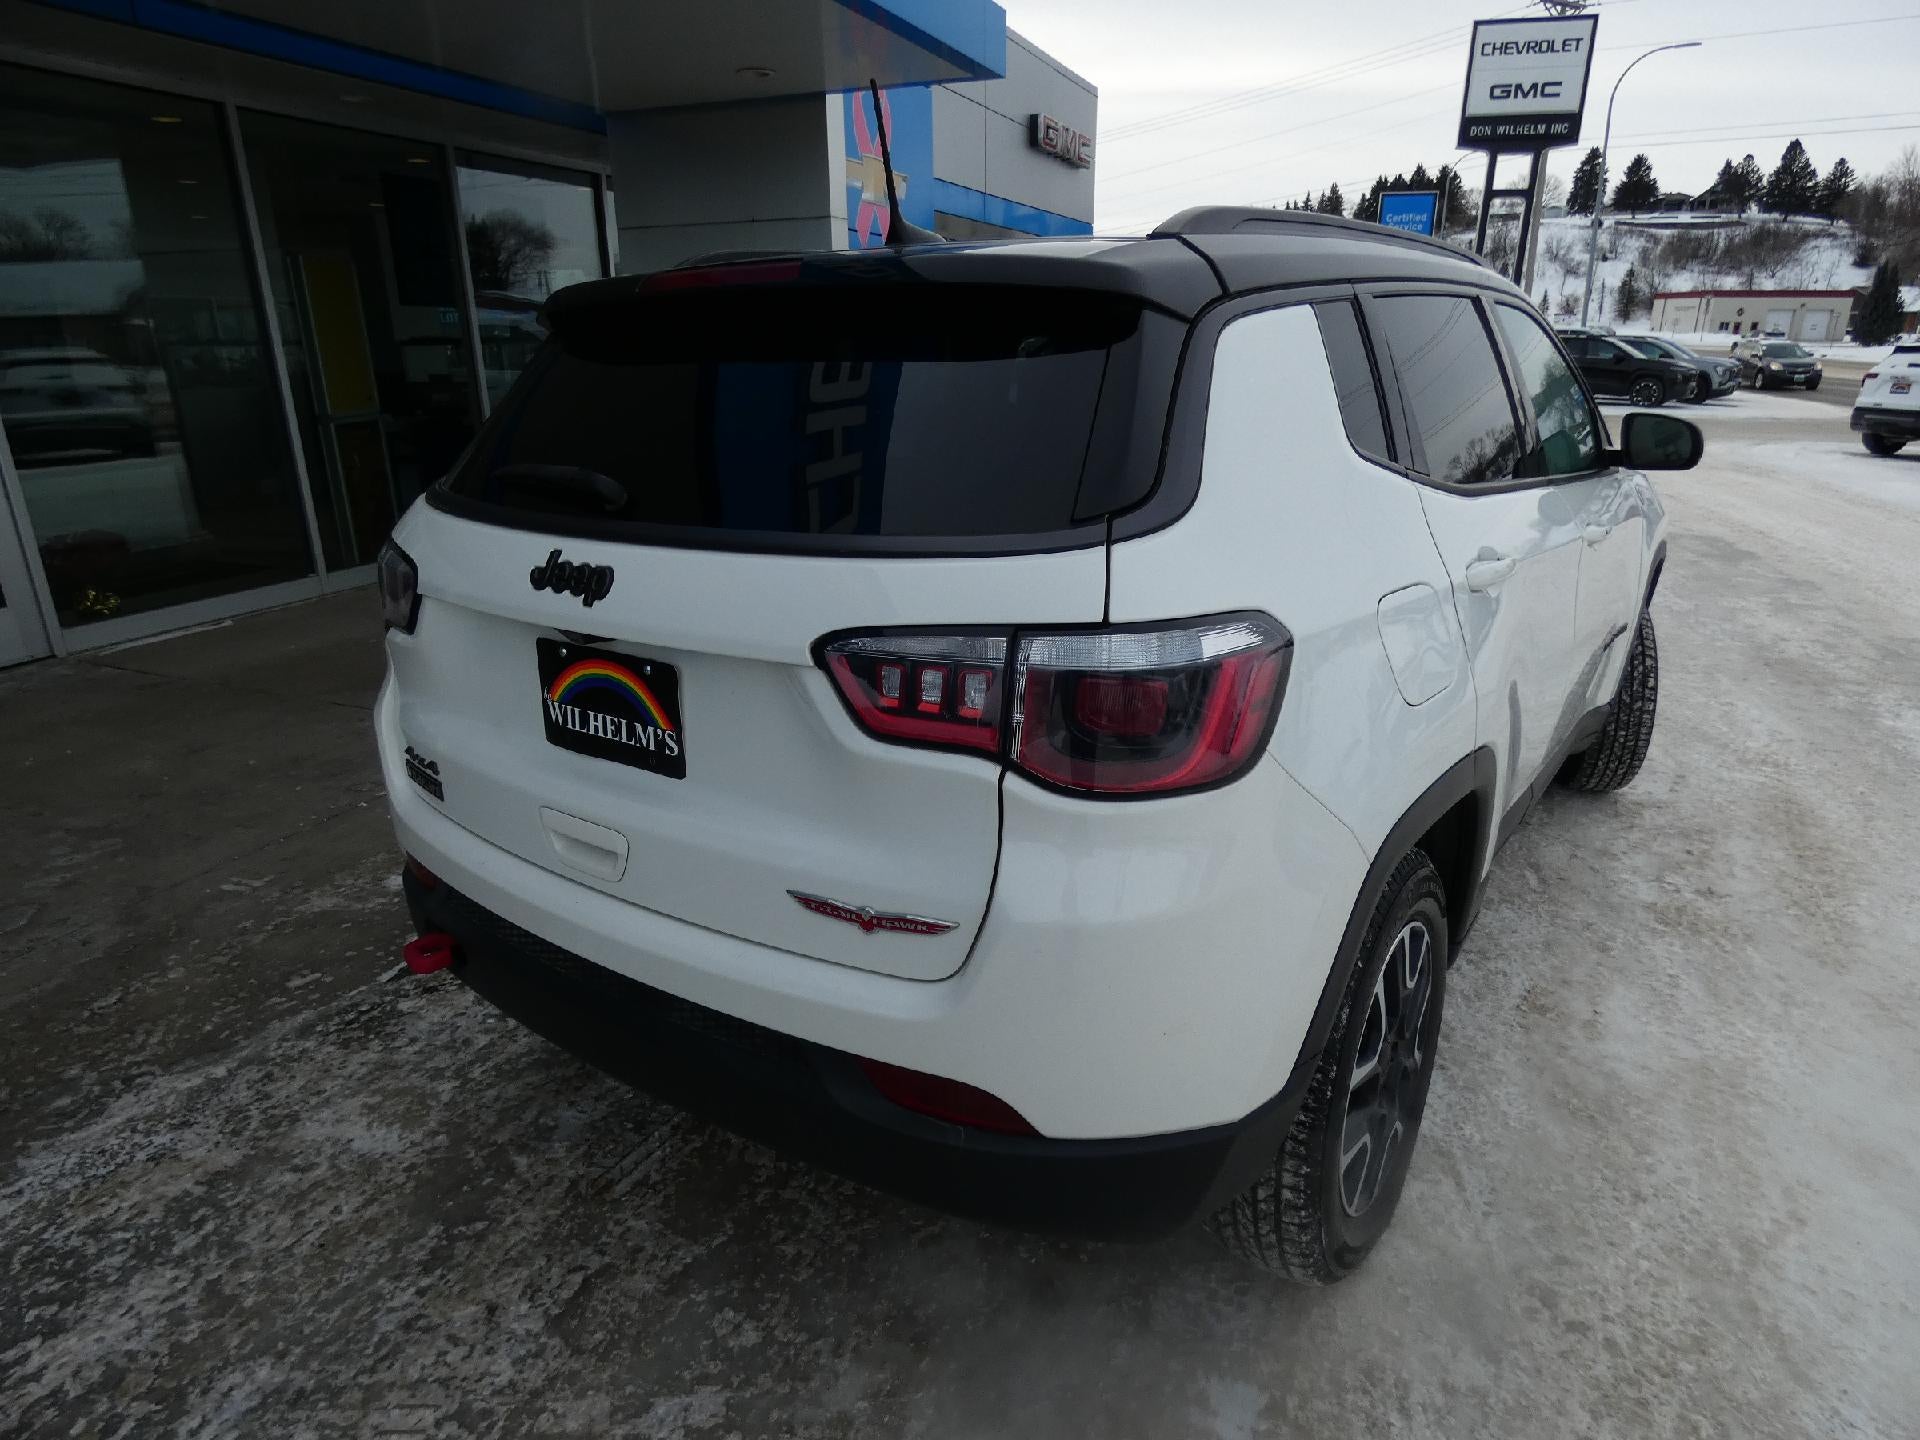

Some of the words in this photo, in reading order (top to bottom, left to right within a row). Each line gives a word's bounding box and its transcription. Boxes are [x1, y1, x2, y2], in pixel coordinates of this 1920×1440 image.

[1480, 37, 1584, 57] CHEVROLET
[1489, 81, 1563, 100] GMC
[1040, 113, 1092, 166] GMC
[1469, 125, 1492, 137] DON
[1496, 123, 1546, 136] WILHELM
[1550, 122, 1570, 134] INC
[1386, 213, 1428, 223] Certified
[530, 549, 614, 608] Jeep
[547, 698, 679, 756] WILHELM'S
